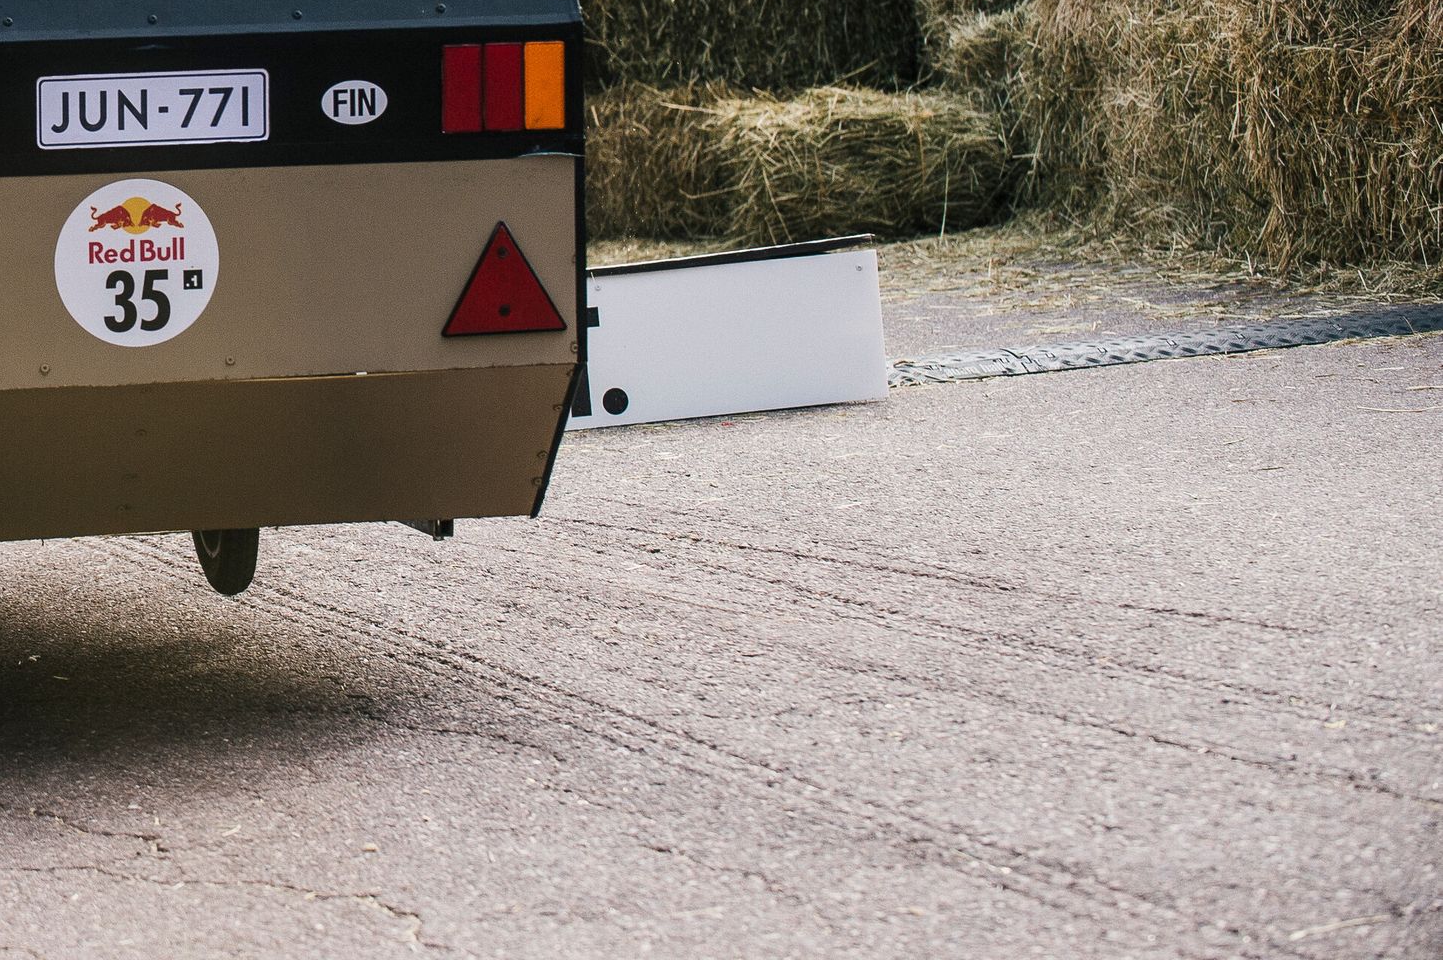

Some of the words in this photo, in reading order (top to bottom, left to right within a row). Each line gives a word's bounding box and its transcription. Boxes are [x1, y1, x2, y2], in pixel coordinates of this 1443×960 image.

[332, 87, 376, 117] FIN
[88, 238, 135, 264] Red
[139, 236, 185, 262] Bull
[103, 269, 171, 333] 35
